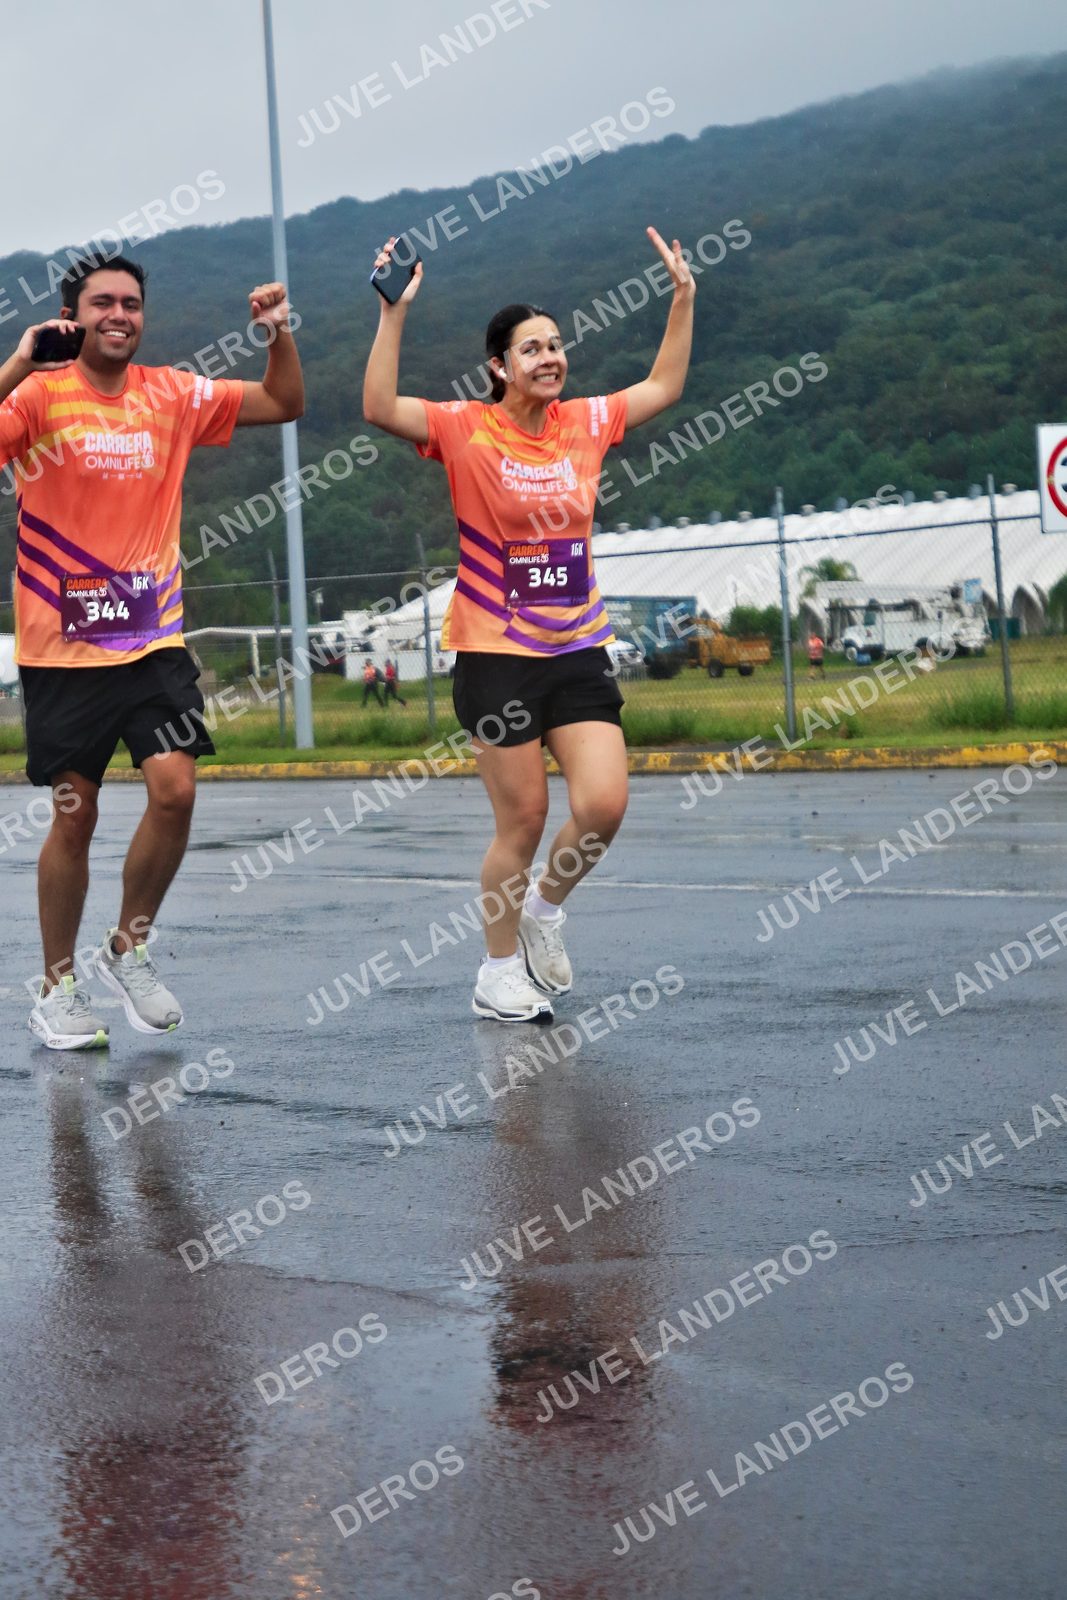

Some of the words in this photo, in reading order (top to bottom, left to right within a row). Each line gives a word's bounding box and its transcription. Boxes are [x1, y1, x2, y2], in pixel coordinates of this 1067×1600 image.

[84, 430, 153, 454] CARRERA
[501, 456, 573, 480] CARRERA
[509, 544, 549, 556] CARRERA
[570, 542, 584, 557] 16K
[66, 577, 108, 590] CARRERA
[132, 576, 149, 590] 16K
[528, 566, 568, 588] 345
[86, 600, 130, 622] 344
